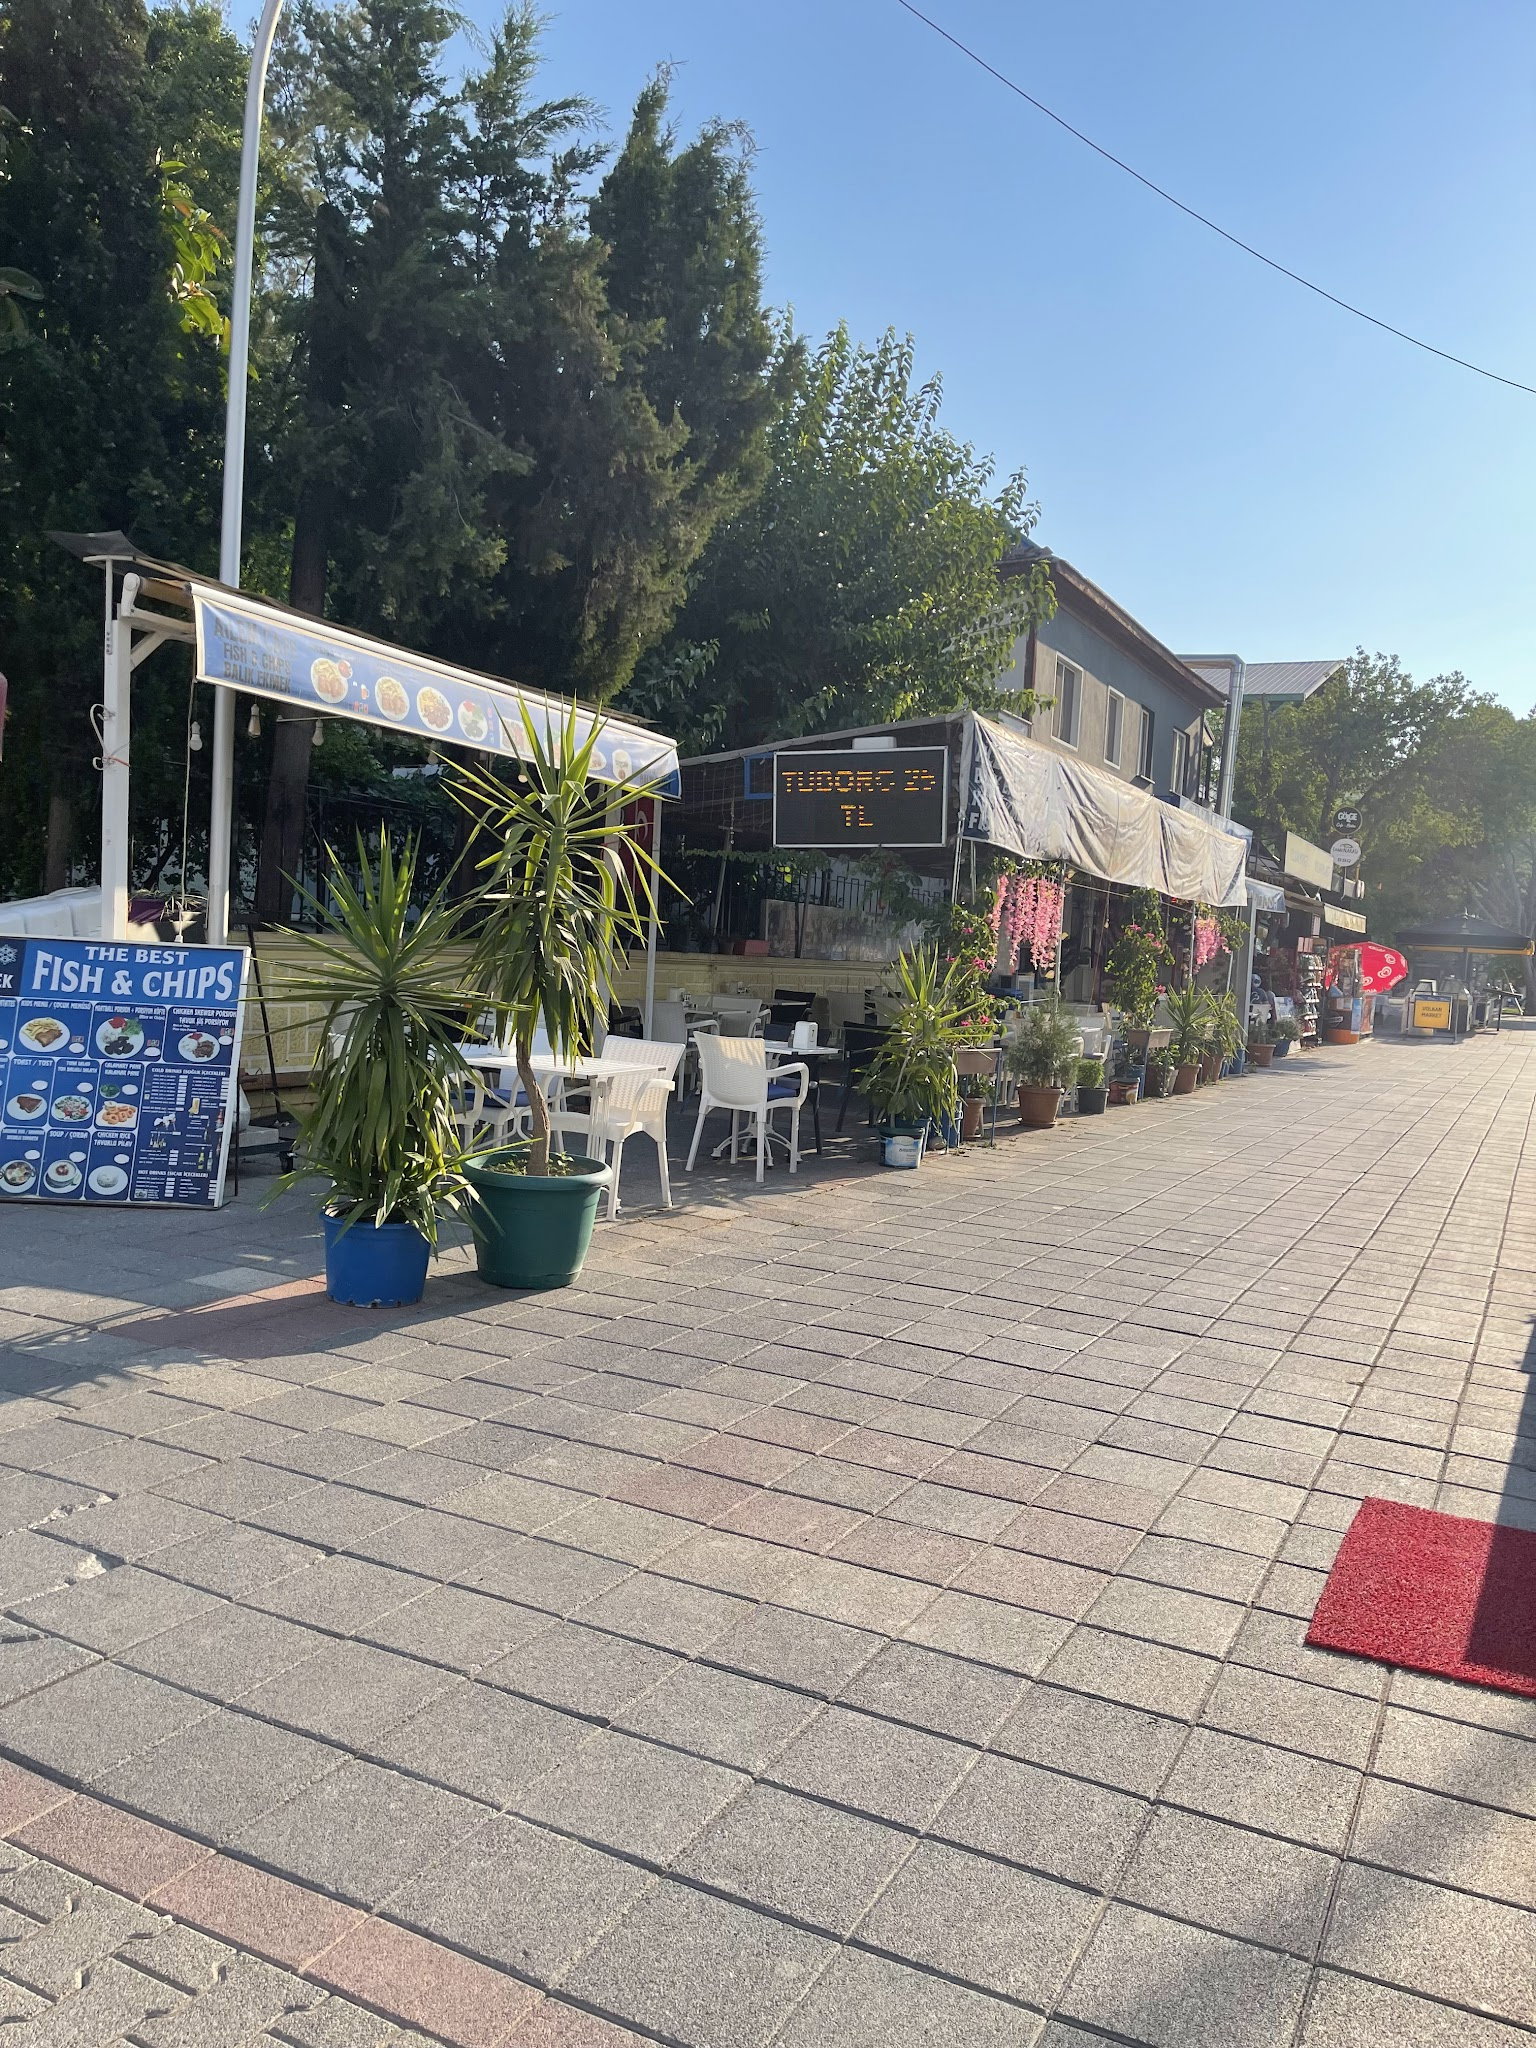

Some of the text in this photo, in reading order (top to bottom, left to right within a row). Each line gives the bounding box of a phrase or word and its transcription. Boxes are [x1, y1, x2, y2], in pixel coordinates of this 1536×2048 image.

[224, 643, 247, 662] FISH
[781, 770, 895, 792] TUBORG
[840, 804, 874, 827] TL
[85, 946, 190, 965] THE BEST
[32, 950, 234, 1001] FISH & CHIPS
[173, 1007, 193, 1016] CHICKEN
[194, 1009, 214, 1017] SKEWER
[14, 1058, 32, 1066] TOAST
[38, 1059, 53, 1067] TOST
[97, 1131, 118, 1139] CHICKEN
